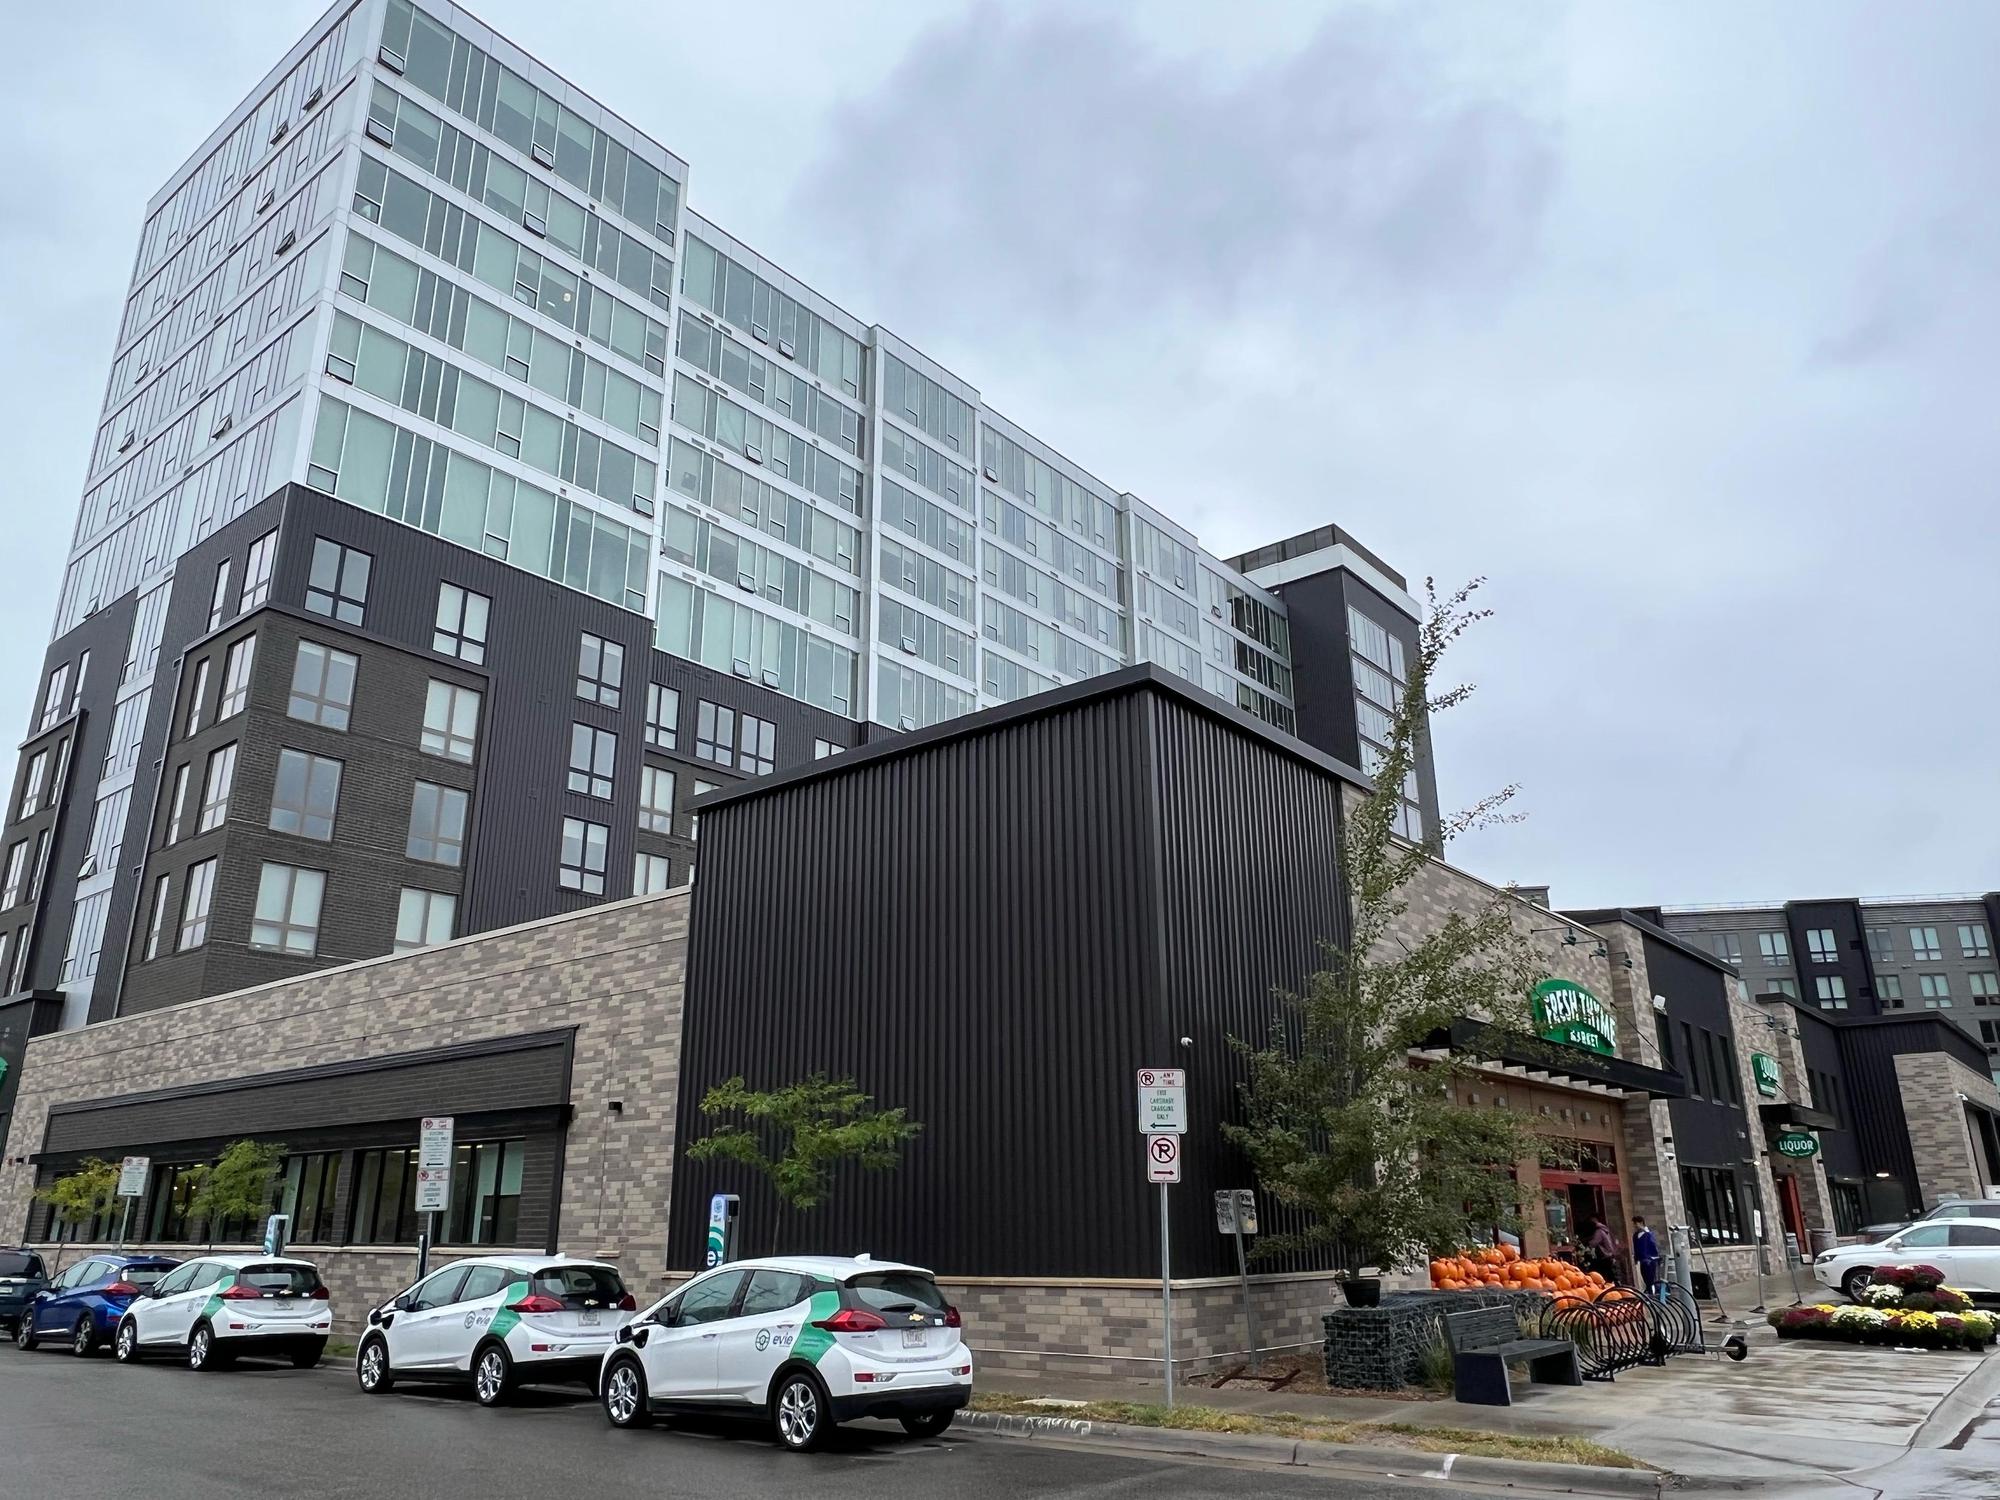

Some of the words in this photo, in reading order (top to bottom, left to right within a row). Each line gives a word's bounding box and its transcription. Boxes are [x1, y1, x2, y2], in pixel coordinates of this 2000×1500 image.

[1544, 989, 1580, 1029] FRESH
[1779, 1140, 1814, 1152] LIQUOR
[772, 1332, 794, 1345] evie
